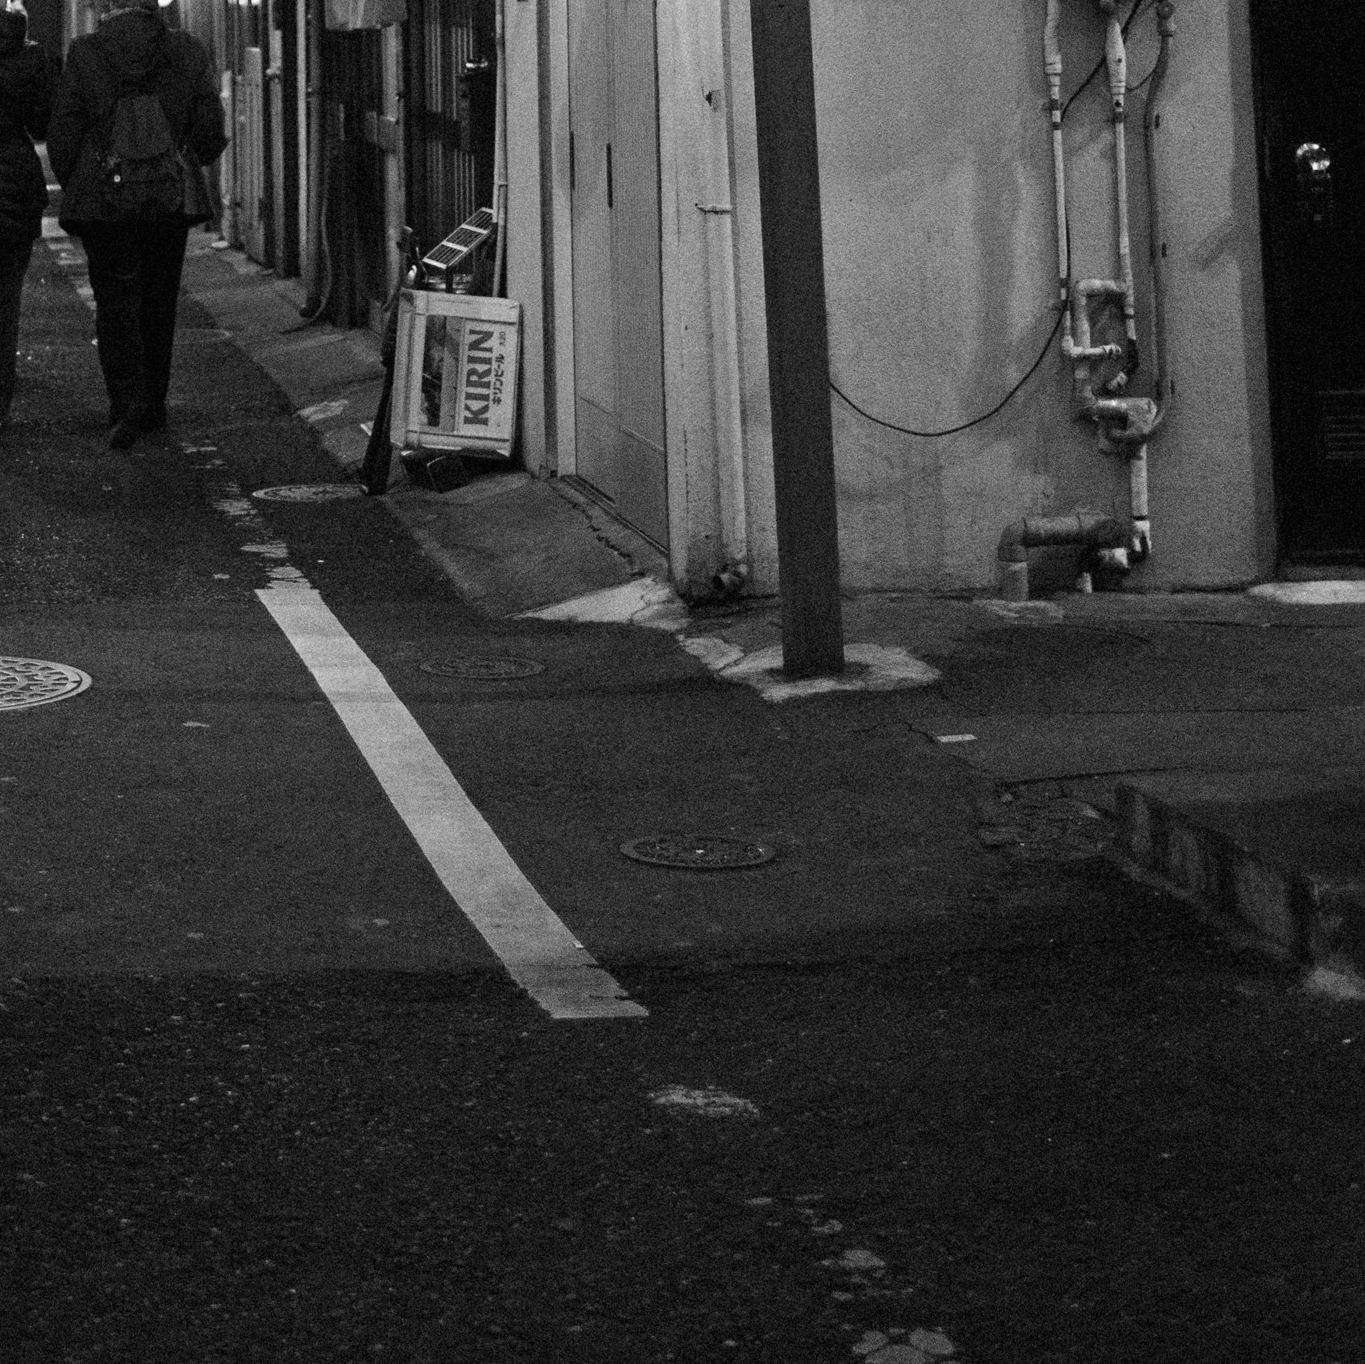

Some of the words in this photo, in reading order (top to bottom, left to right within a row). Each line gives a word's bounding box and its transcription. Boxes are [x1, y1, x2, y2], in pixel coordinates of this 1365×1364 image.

[463, 328, 495, 427] KIRIN
[492, 353, 506, 405] キリンビール
